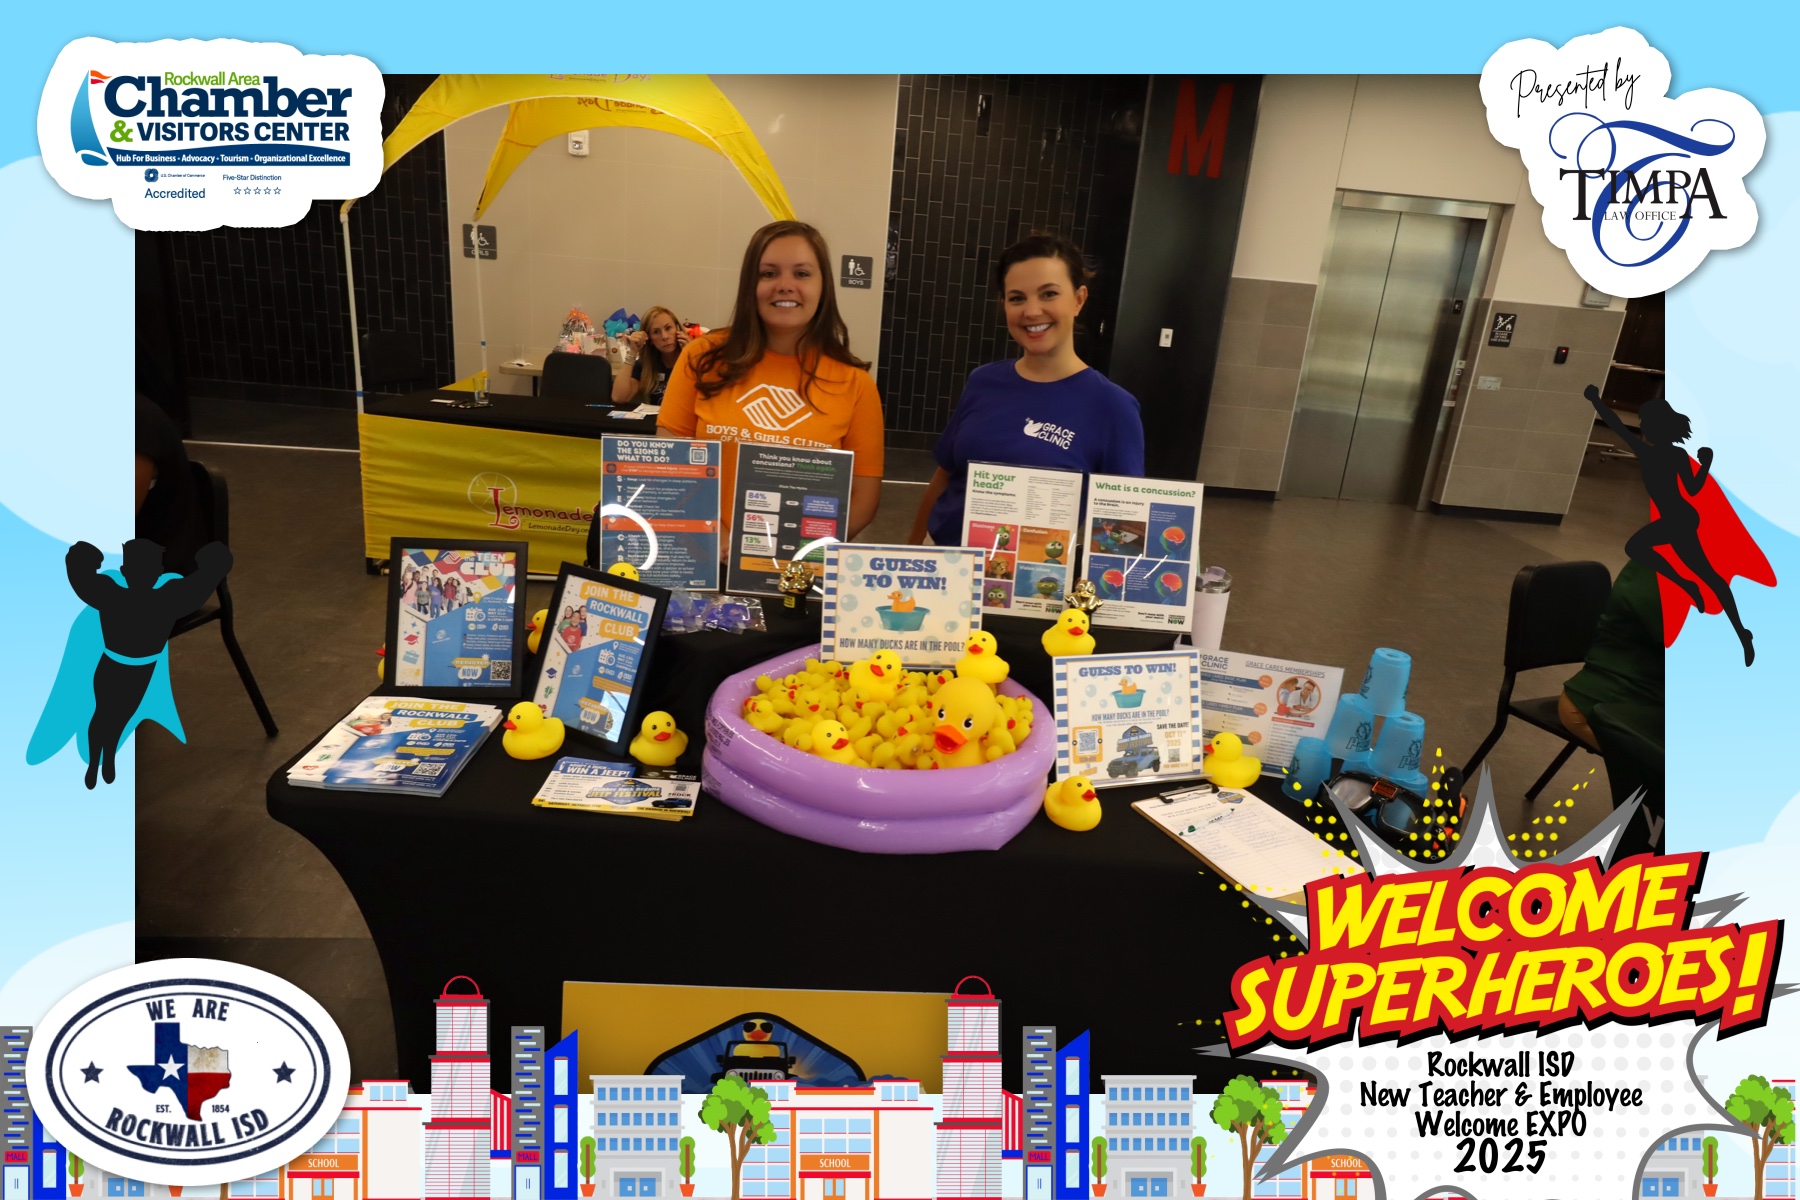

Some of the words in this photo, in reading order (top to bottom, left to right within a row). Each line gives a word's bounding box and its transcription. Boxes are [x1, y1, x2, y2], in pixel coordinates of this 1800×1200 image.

[1166, 78, 1233, 178] M
[707, 425, 738, 435] BOYS
[741, 429, 751, 438] &
[754, 432, 789, 444] GIRLS
[1043, 423, 1075, 441] GRACE
[1039, 431, 1070, 449] CLINIC
[752, 460, 795, 468] concussions?
[974, 470, 990, 479] Hit
[992, 473, 1016, 482] your
[973, 479, 1004, 489] head?
[1096, 482, 1121, 491] What
[1124, 484, 1130, 492] is
[1141, 488, 1195, 497] concussion?
[748, 492, 766, 500] 84%
[487, 488, 593, 530] Lemonade
[477, 553, 506, 562] TEEN
[461, 562, 515, 576] CLUB
[870, 557, 937, 573] GUESS
[863, 575, 892, 588] TO
[897, 576, 946, 590] WIN!
[584, 585, 609, 598] JOIN
[613, 589, 634, 602] THE
[590, 600, 643, 623] ROCKWALL
[605, 623, 634, 636] CLUB
[840, 638, 855, 648] HOW
[857, 639, 878, 649] MANY
[880, 640, 902, 649] DUCKS
[904, 640, 918, 650] ARE
[920, 641, 927, 650] IN
[929, 641, 942, 651] THE
[944, 642, 965, 652] POOL?
[1201, 661, 1227, 669] CLINIC
[1203, 655, 1228, 663] GRACE
[462, 668, 478, 676] NOW
[1079, 666, 1122, 677] GUESS
[1125, 665, 1143, 674] TO
[1146, 663, 1176, 673] WIN!
[1246, 661, 1263, 669] GRACE
[1265, 663, 1284, 672] CARES
[1285, 667, 1325, 678] MEMBERSHIPS
[391, 701, 424, 709] JOIN
[397, 710, 470, 720] ROCKWALL
[1156, 709, 1169, 717] POOL?
[600, 769, 630, 777] JEEP!
